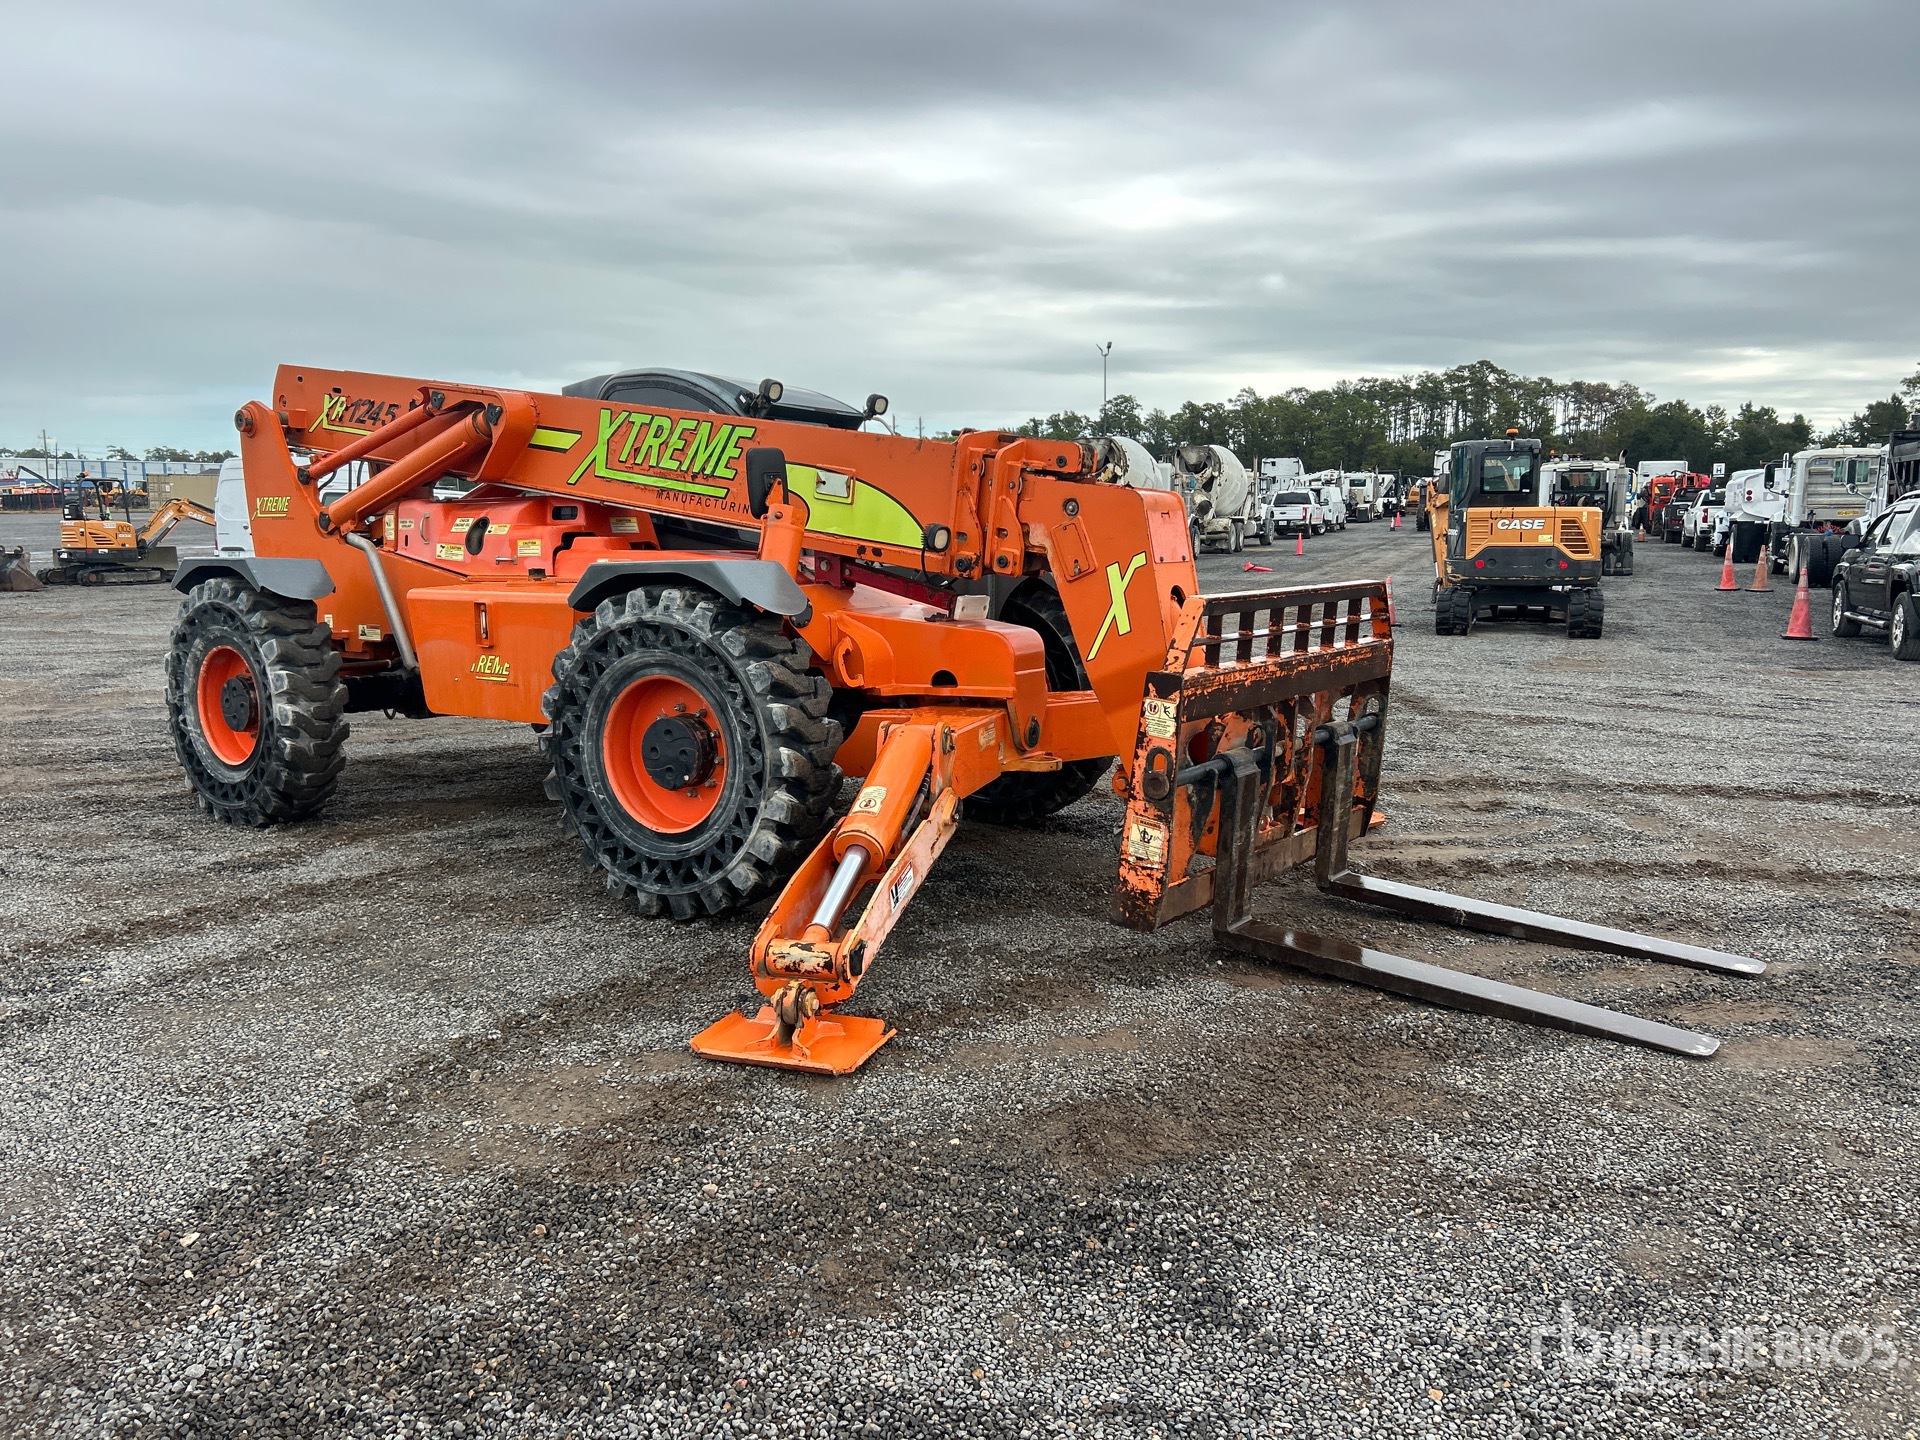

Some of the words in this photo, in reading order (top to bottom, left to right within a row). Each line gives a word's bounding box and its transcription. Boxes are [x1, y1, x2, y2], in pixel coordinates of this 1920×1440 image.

[566, 407, 757, 499] XTREME
[251, 496, 291, 521] XTREME
[655, 489, 751, 515] MANUFACTURIN
[1497, 519, 1545, 530] CASE
